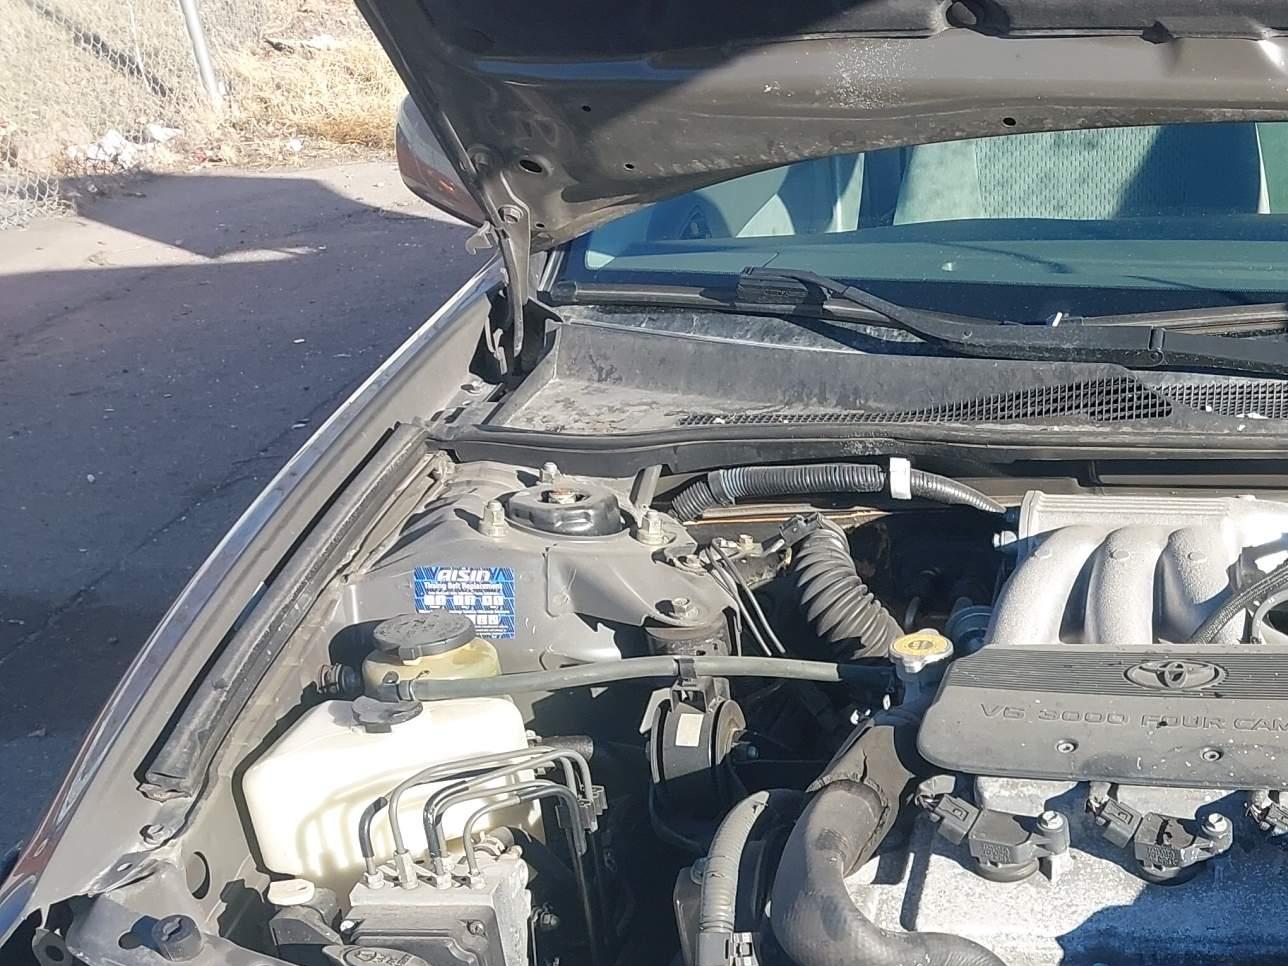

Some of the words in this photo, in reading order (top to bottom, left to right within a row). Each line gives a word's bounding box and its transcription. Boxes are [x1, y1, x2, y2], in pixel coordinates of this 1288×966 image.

[981, 703, 1026, 720] V6
[1037, 708, 1129, 725] 3000
[1141, 713, 1225, 730] FOUR
